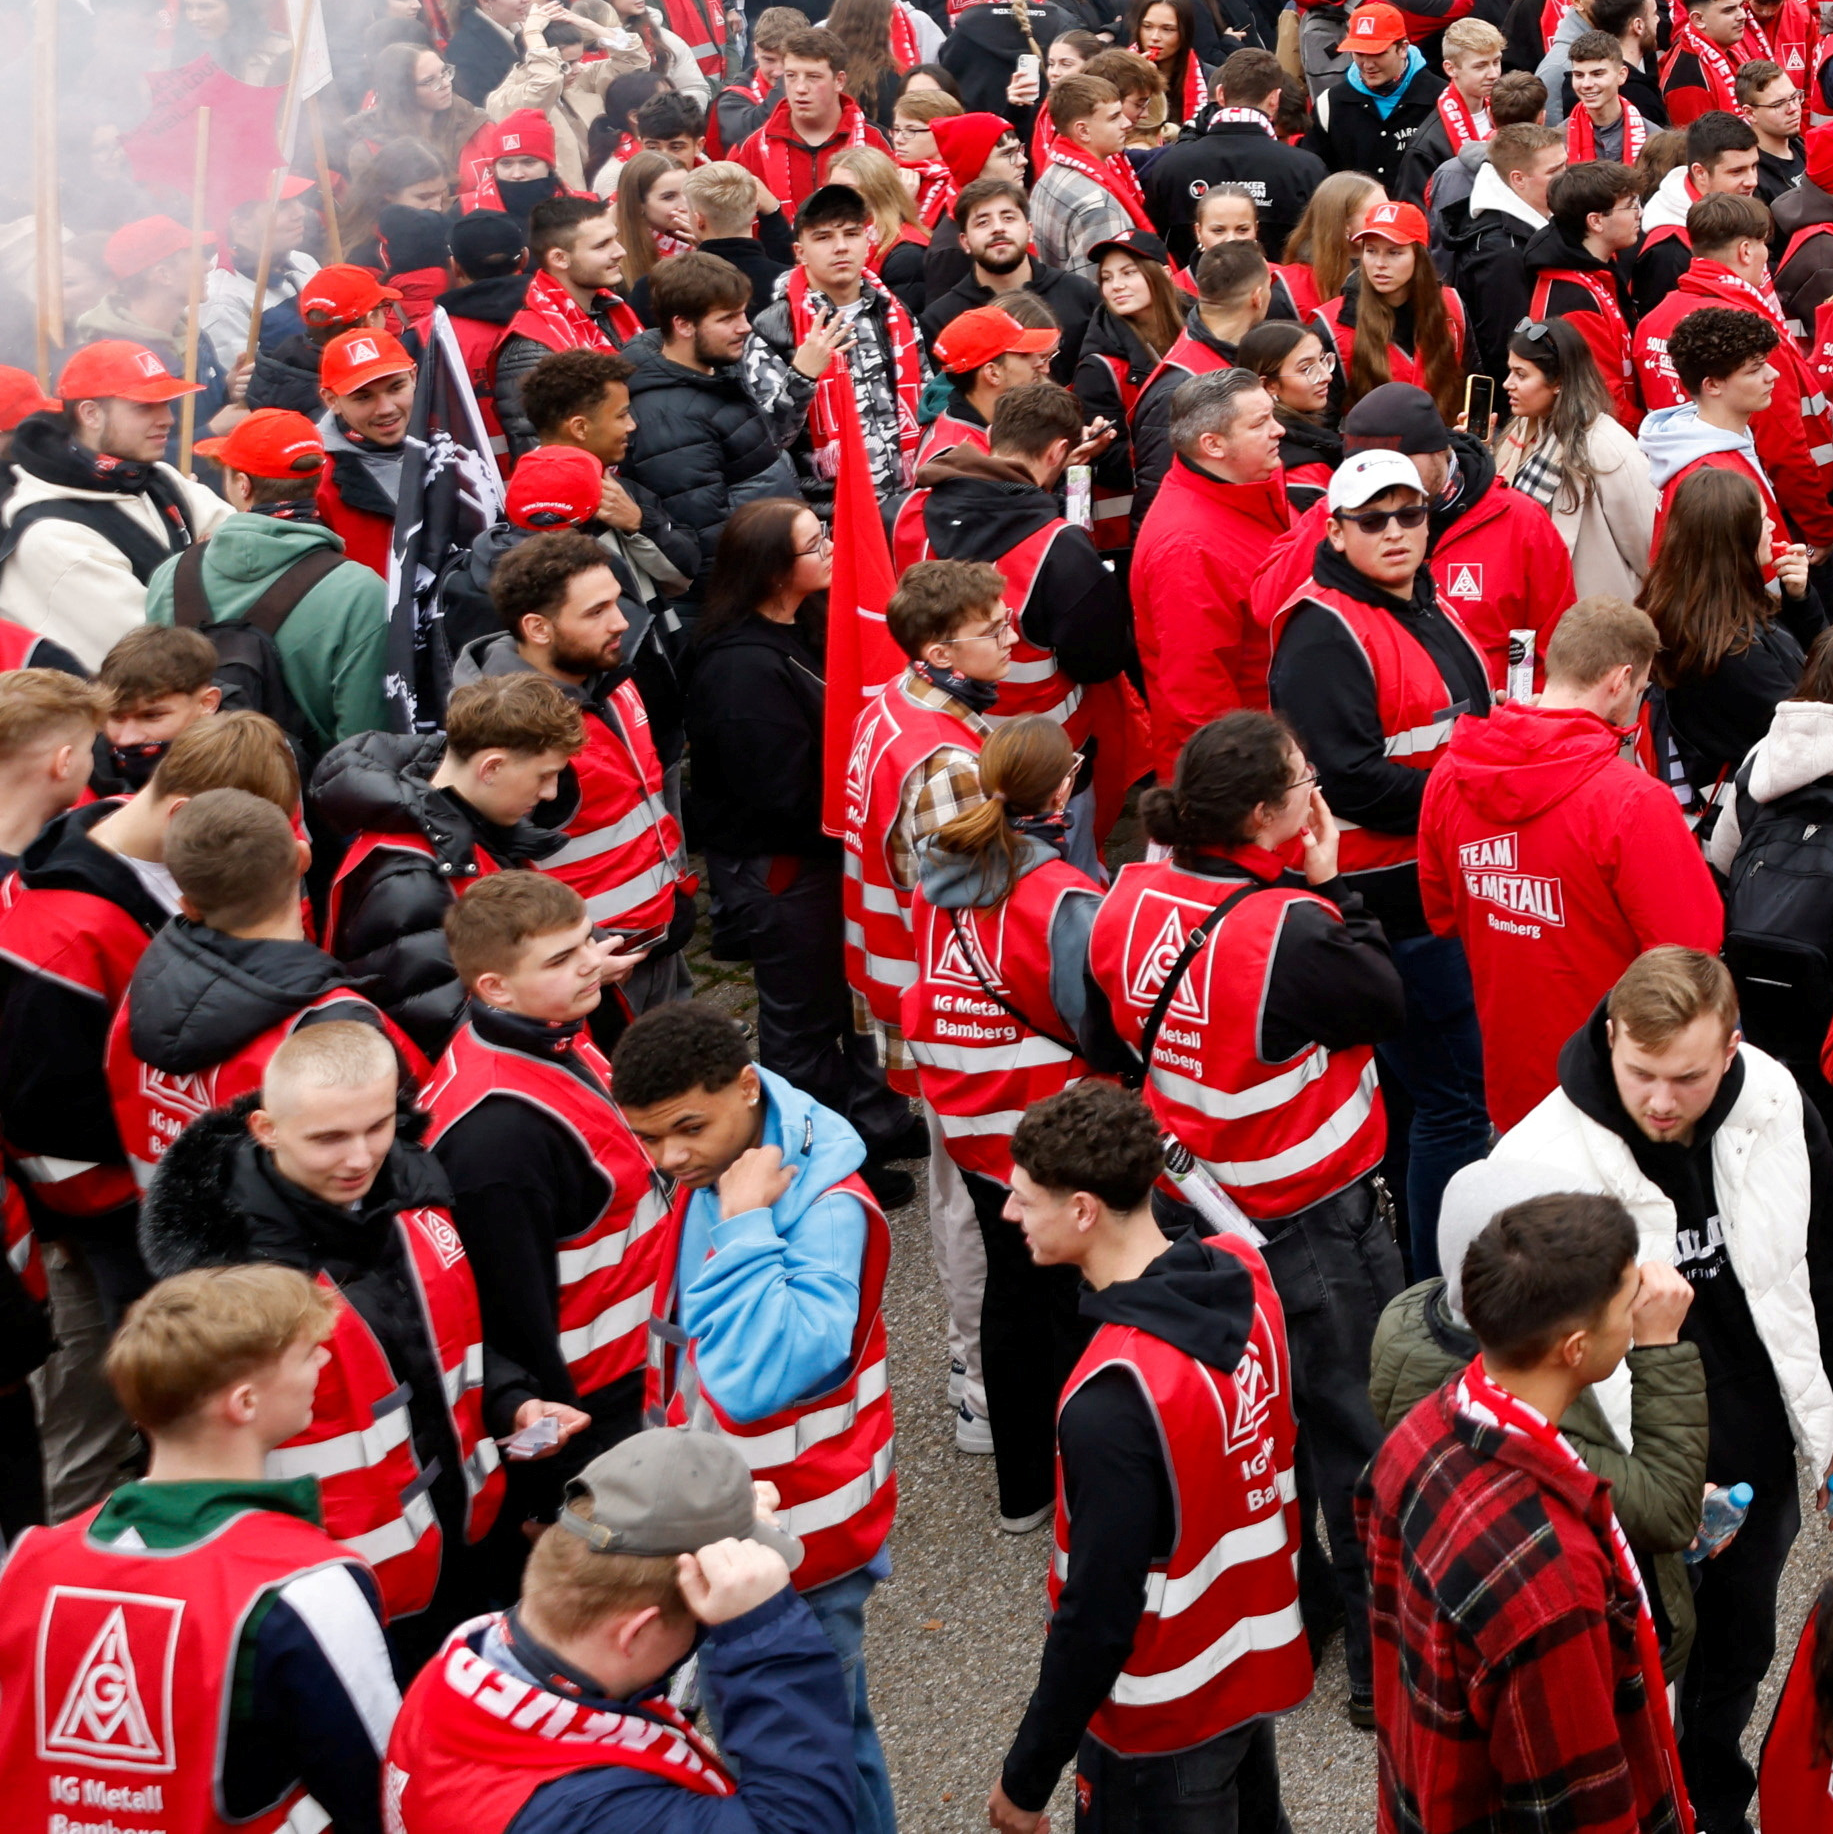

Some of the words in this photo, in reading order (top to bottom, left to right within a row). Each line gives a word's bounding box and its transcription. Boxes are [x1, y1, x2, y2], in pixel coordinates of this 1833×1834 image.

[1520, 671, 1531, 704] OOTER
[1460, 837, 1513, 867] TEAM
[1465, 873, 1480, 897] IG
[1482, 874, 1561, 922] METALL
[1487, 912, 1542, 940] Bamberg
[933, 994, 953, 1013] IG
[954, 996, 1012, 1017] Meta
[935, 1018, 1018, 1042] Bamberg
[51, 1774, 79, 1804] IG
[84, 1778, 164, 1813] Metall
